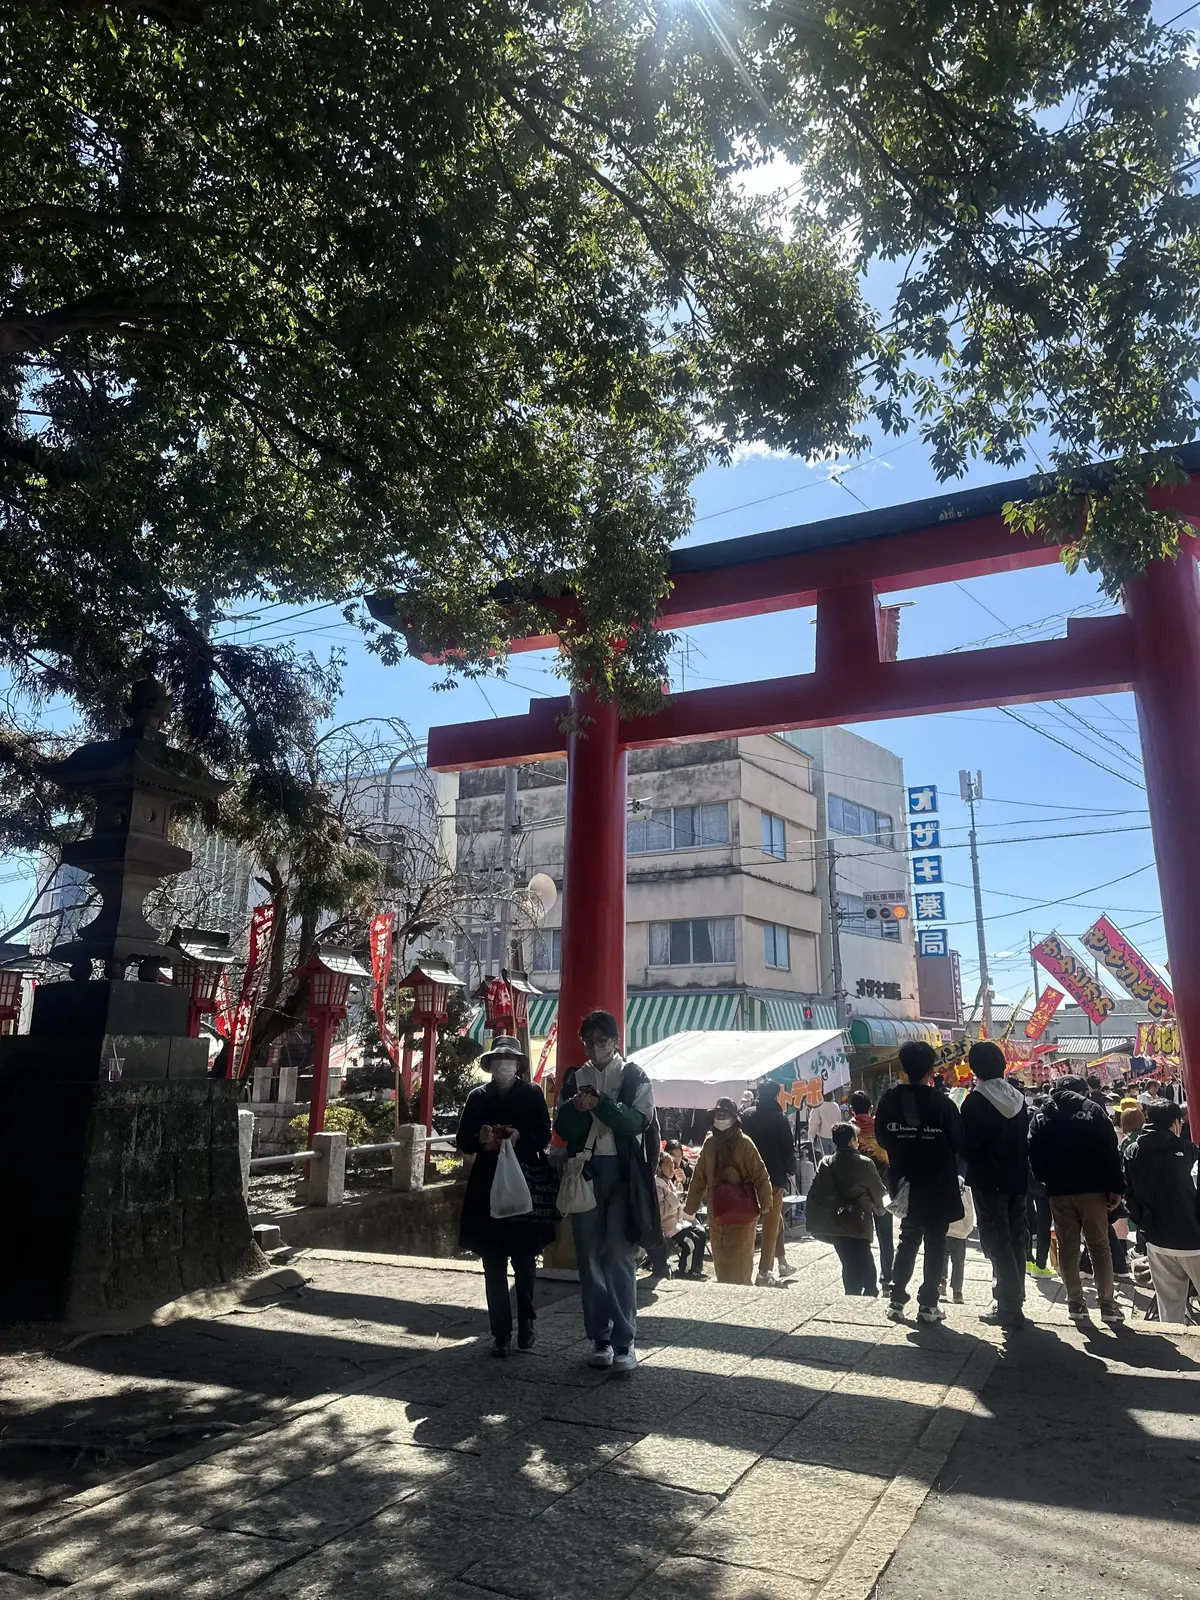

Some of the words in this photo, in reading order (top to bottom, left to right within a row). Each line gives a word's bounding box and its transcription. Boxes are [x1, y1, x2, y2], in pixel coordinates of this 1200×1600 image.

[910, 787, 945, 955] オザキ薬局
[1041, 937, 1116, 1017] ザ・タピオカ
